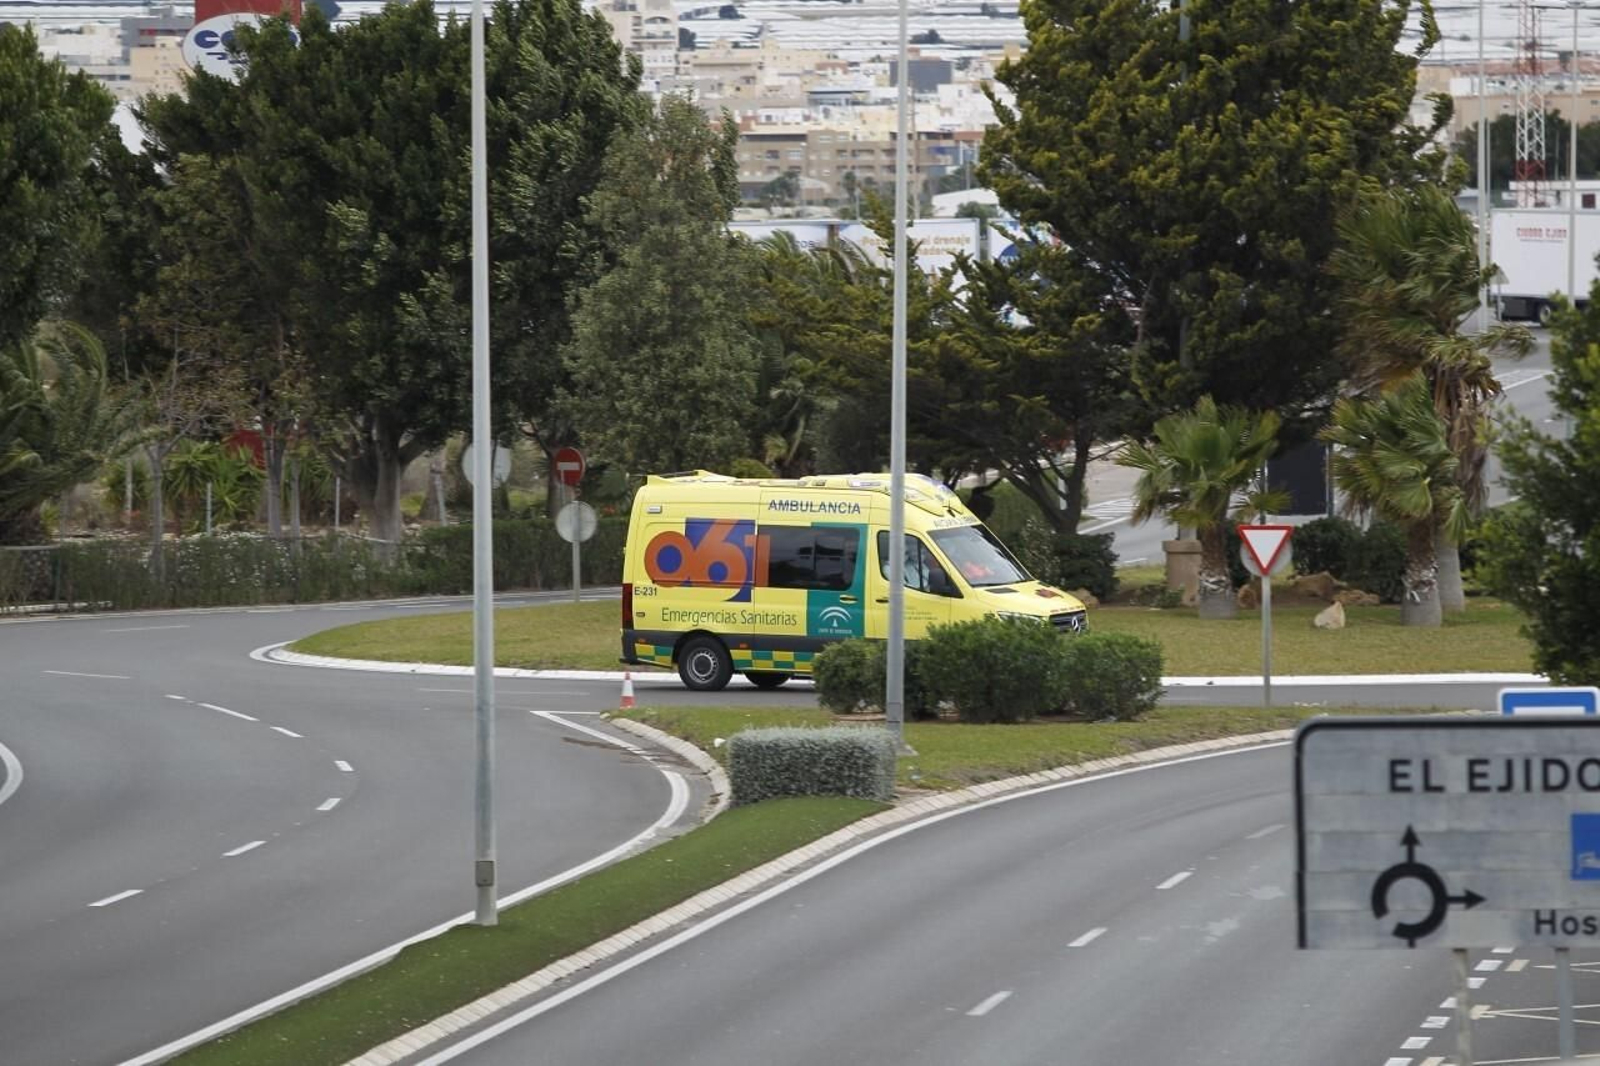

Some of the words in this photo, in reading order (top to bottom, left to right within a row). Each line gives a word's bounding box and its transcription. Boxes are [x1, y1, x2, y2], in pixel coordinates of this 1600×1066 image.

[768, 500, 862, 514] AMBULANCIA
[644, 519, 770, 589] 061
[634, 587, 658, 596] E-231
[661, 607, 737, 626] Emergencias
[740, 609, 798, 627] Sanitarias
[1389, 758, 1445, 793] EL
[1466, 757, 1600, 793] EJIDO
